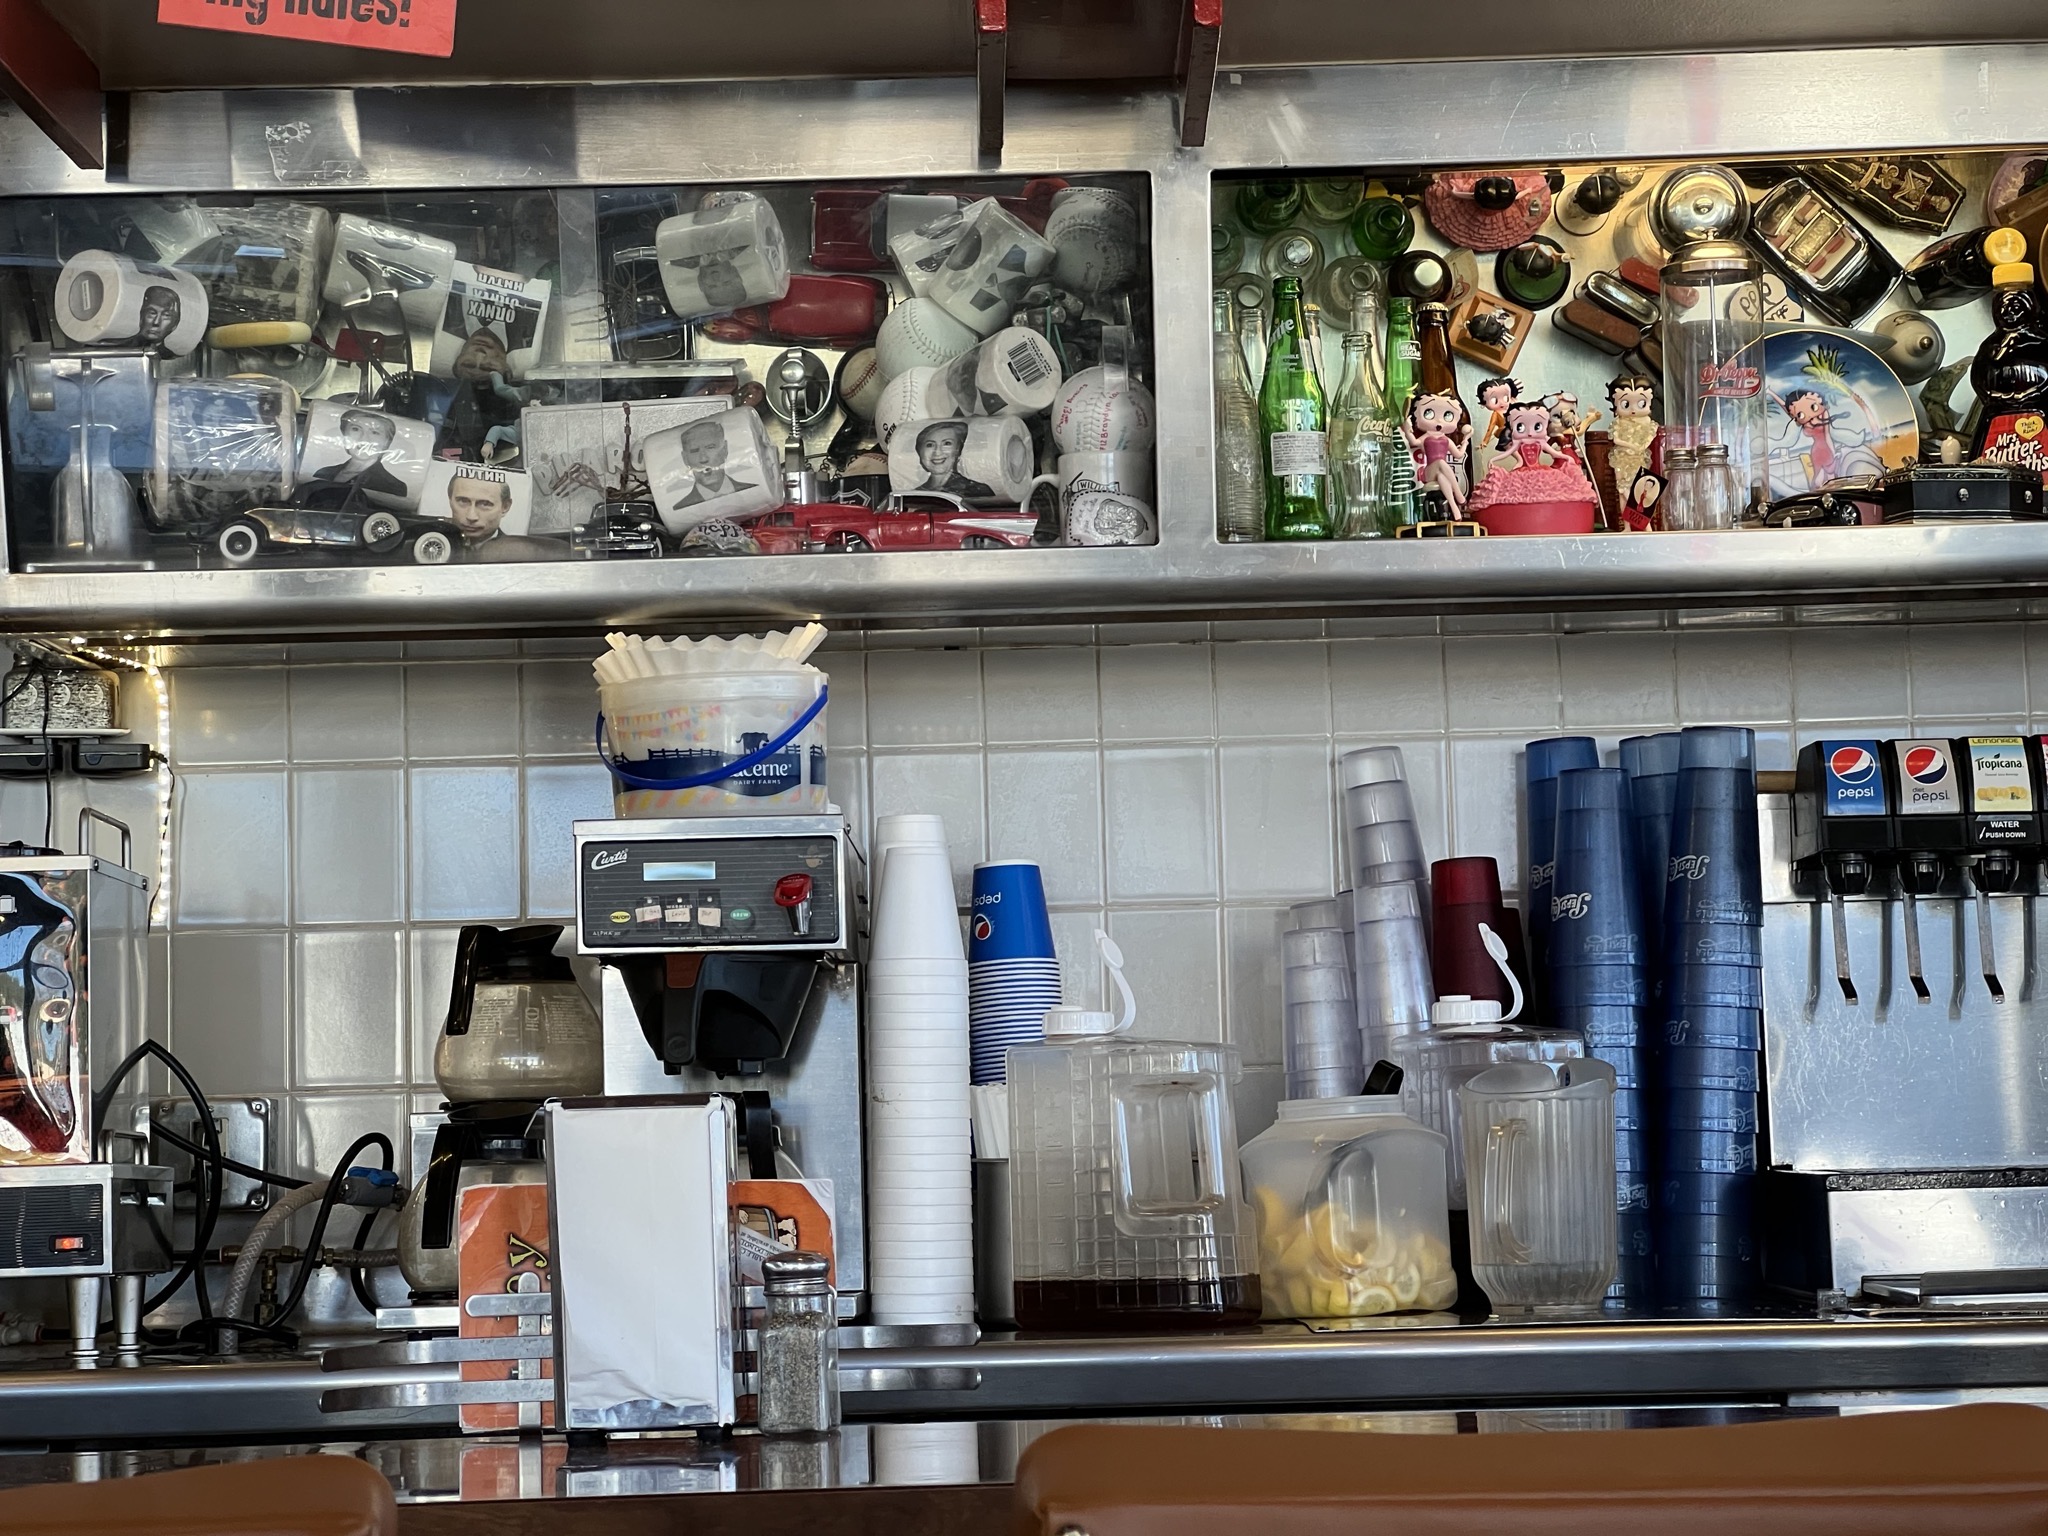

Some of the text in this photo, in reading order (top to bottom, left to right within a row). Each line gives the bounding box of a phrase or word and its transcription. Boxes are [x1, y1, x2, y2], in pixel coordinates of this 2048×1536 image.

[1996, 433, 2019, 447] Mrs.
[456, 466, 506, 484] ПУТИН
[1974, 756, 2023, 771] Tropicana
[1837, 786, 1874, 800] pepsi
[1912, 790, 1950, 804] pepsi
[591, 849, 628, 871] Curtis
